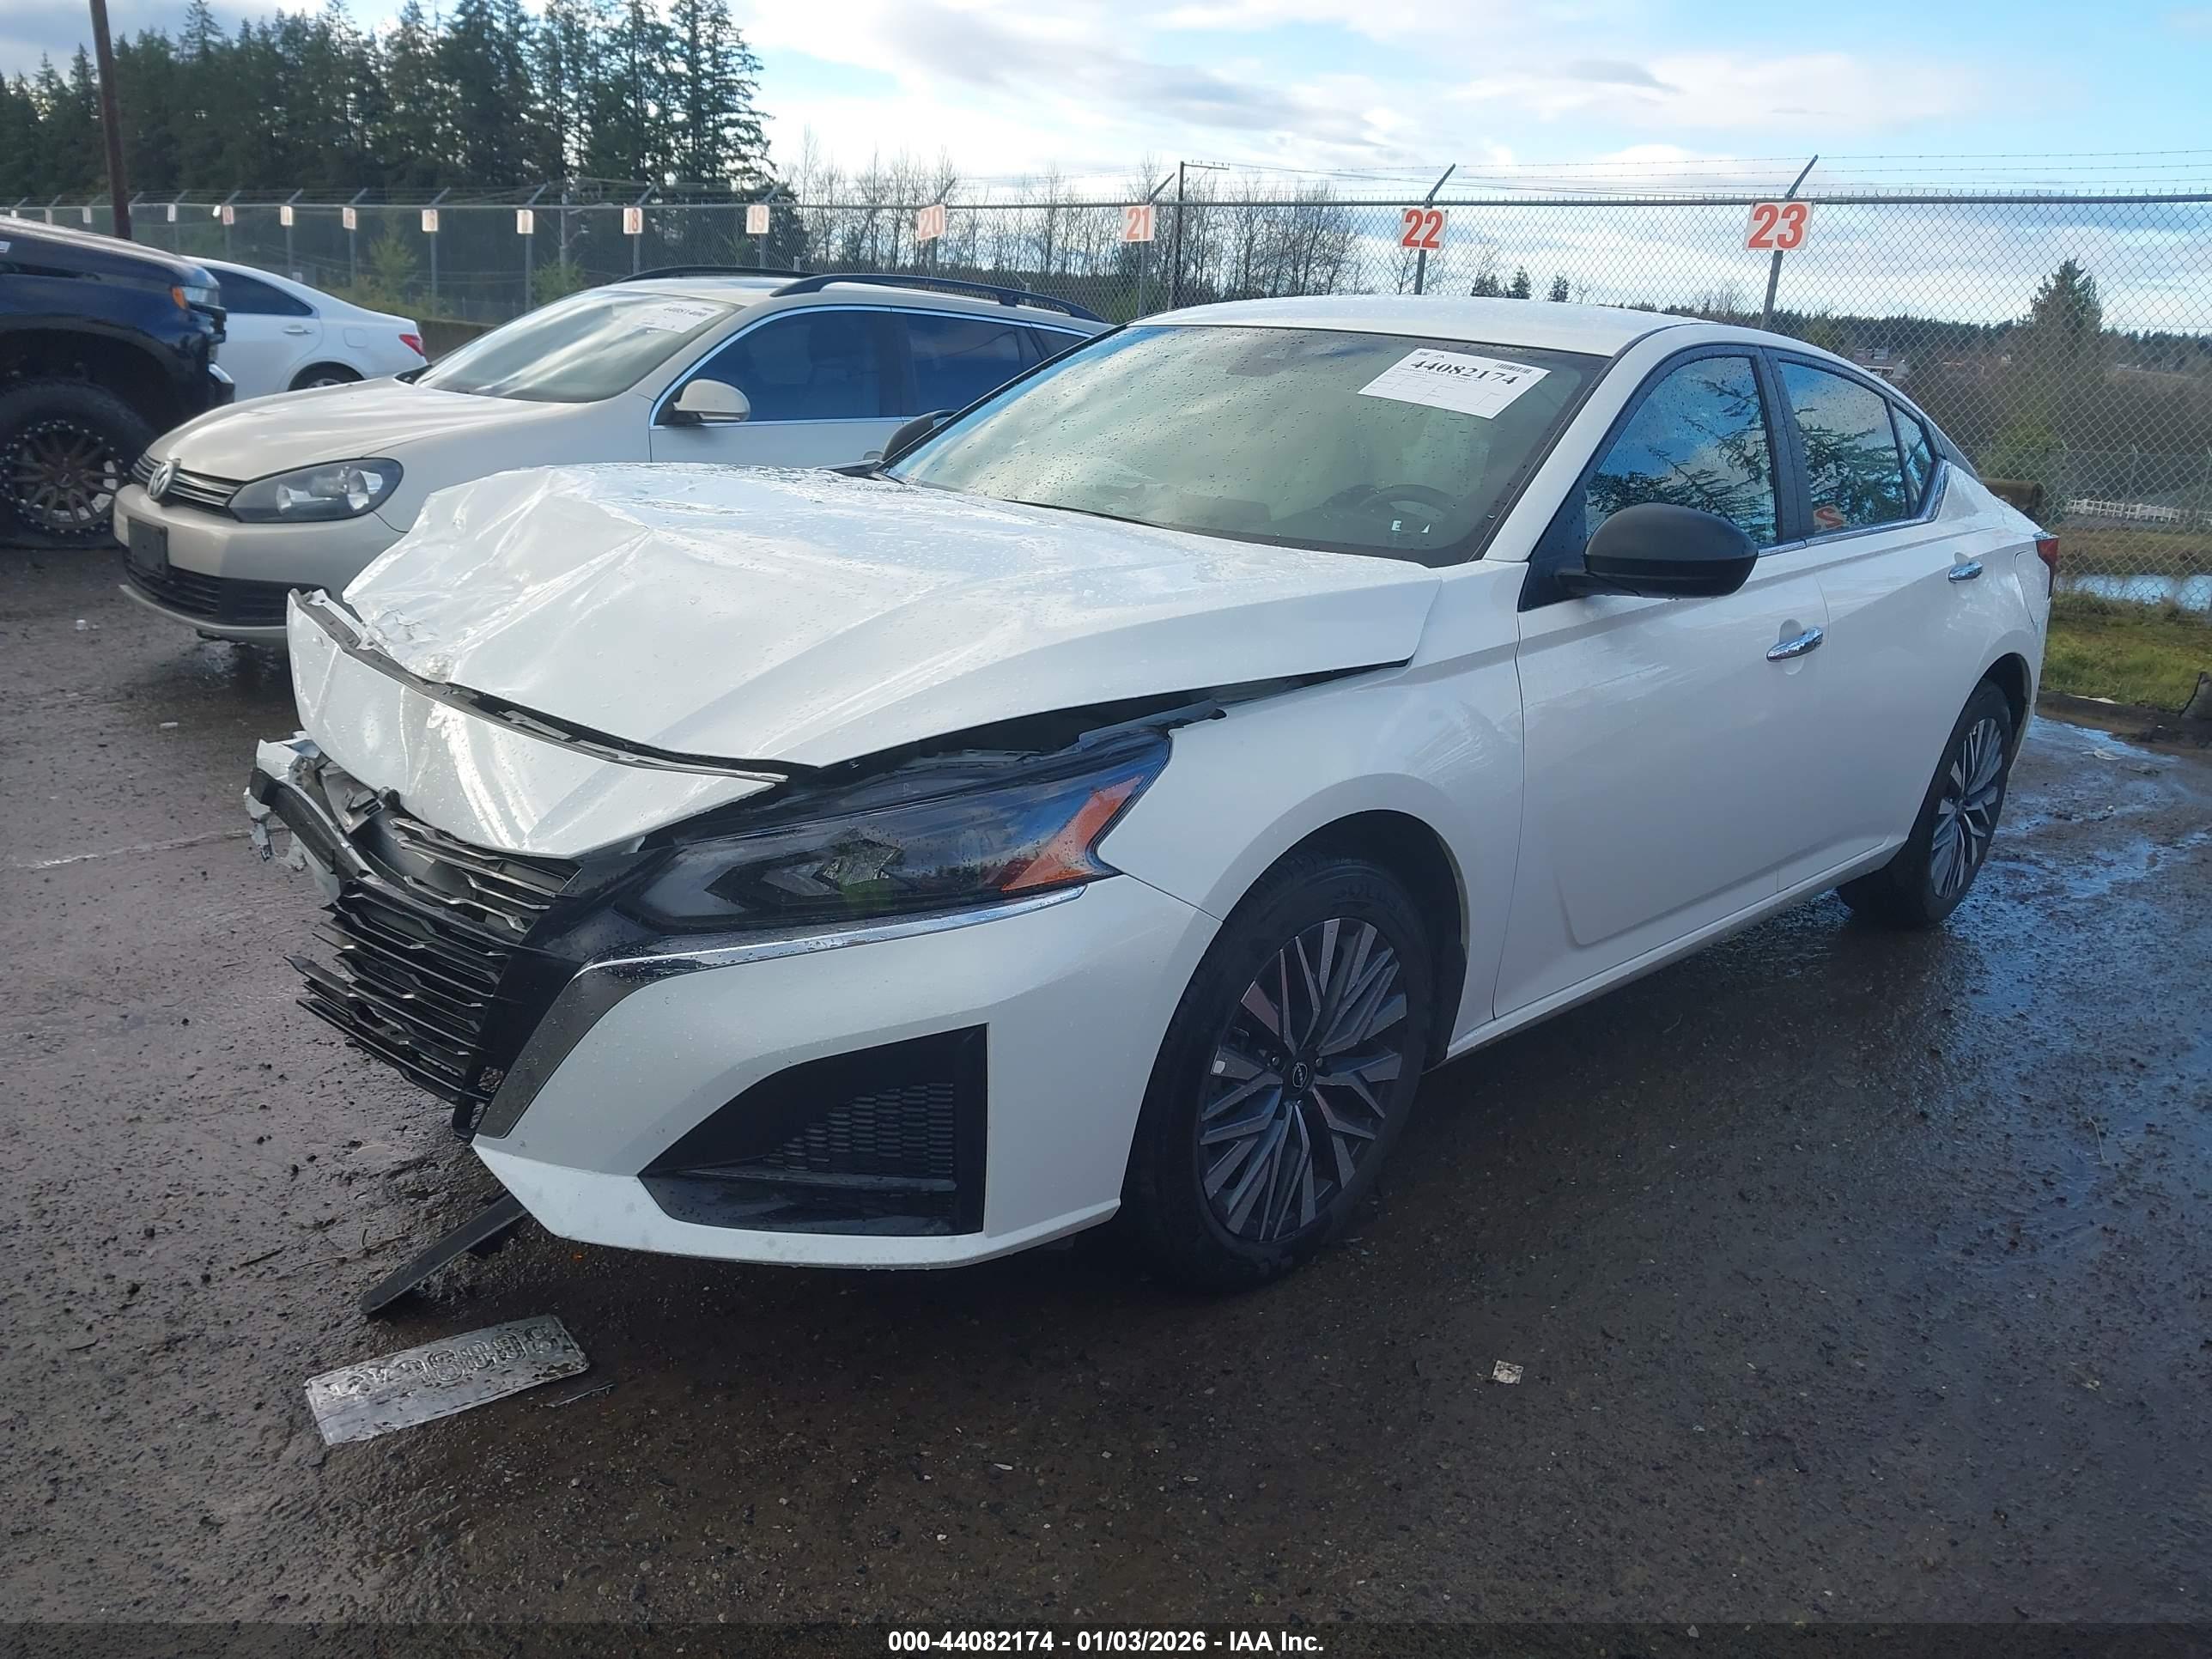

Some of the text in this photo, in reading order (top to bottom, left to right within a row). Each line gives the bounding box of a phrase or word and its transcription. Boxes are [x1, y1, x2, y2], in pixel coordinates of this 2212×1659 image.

[750, 205, 767, 232] 19
[920, 205, 944, 239] 20
[1126, 206, 1151, 240] 21
[1402, 209, 1443, 249] 22
[1747, 204, 1808, 249] 23
[1410, 360, 1520, 386] 44082174
